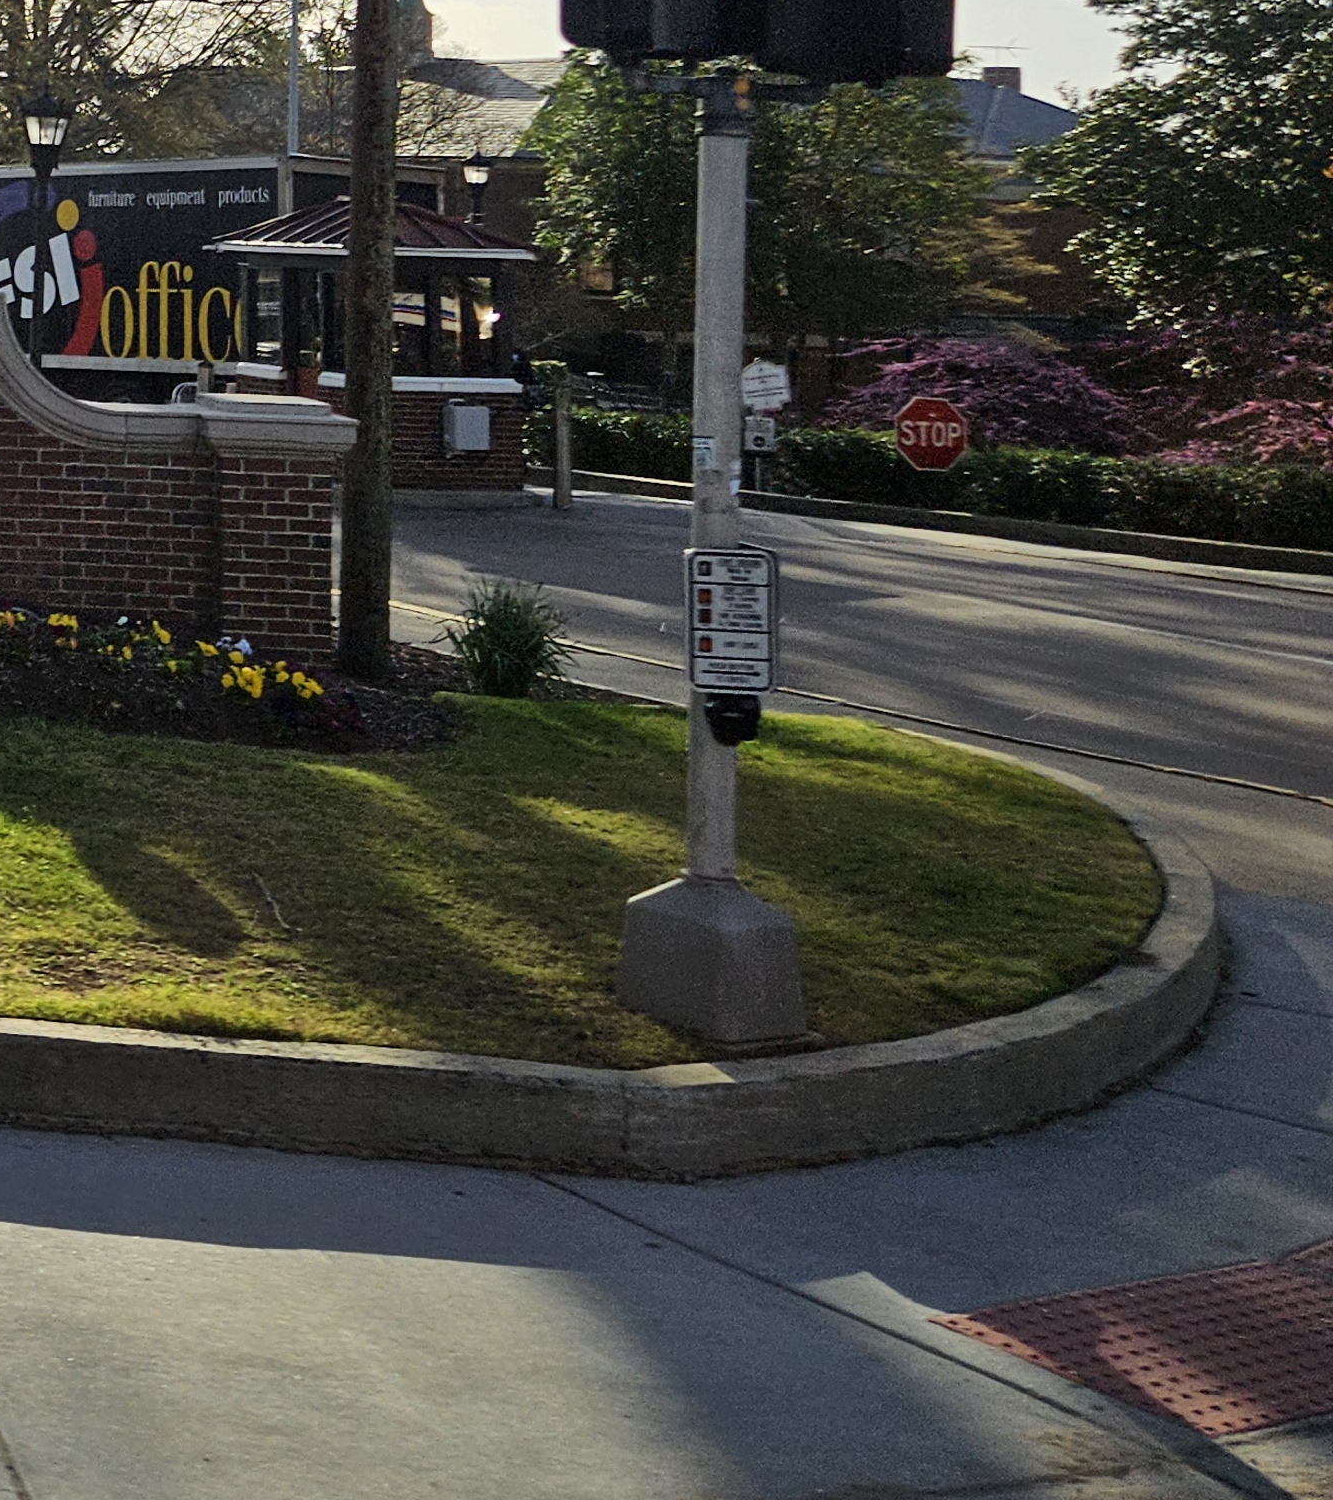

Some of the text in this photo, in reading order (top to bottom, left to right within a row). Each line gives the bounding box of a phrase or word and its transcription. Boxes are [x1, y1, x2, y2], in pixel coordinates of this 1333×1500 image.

[88, 186, 270, 209] furniture equipment products
[899, 419, 962, 448] STOP
